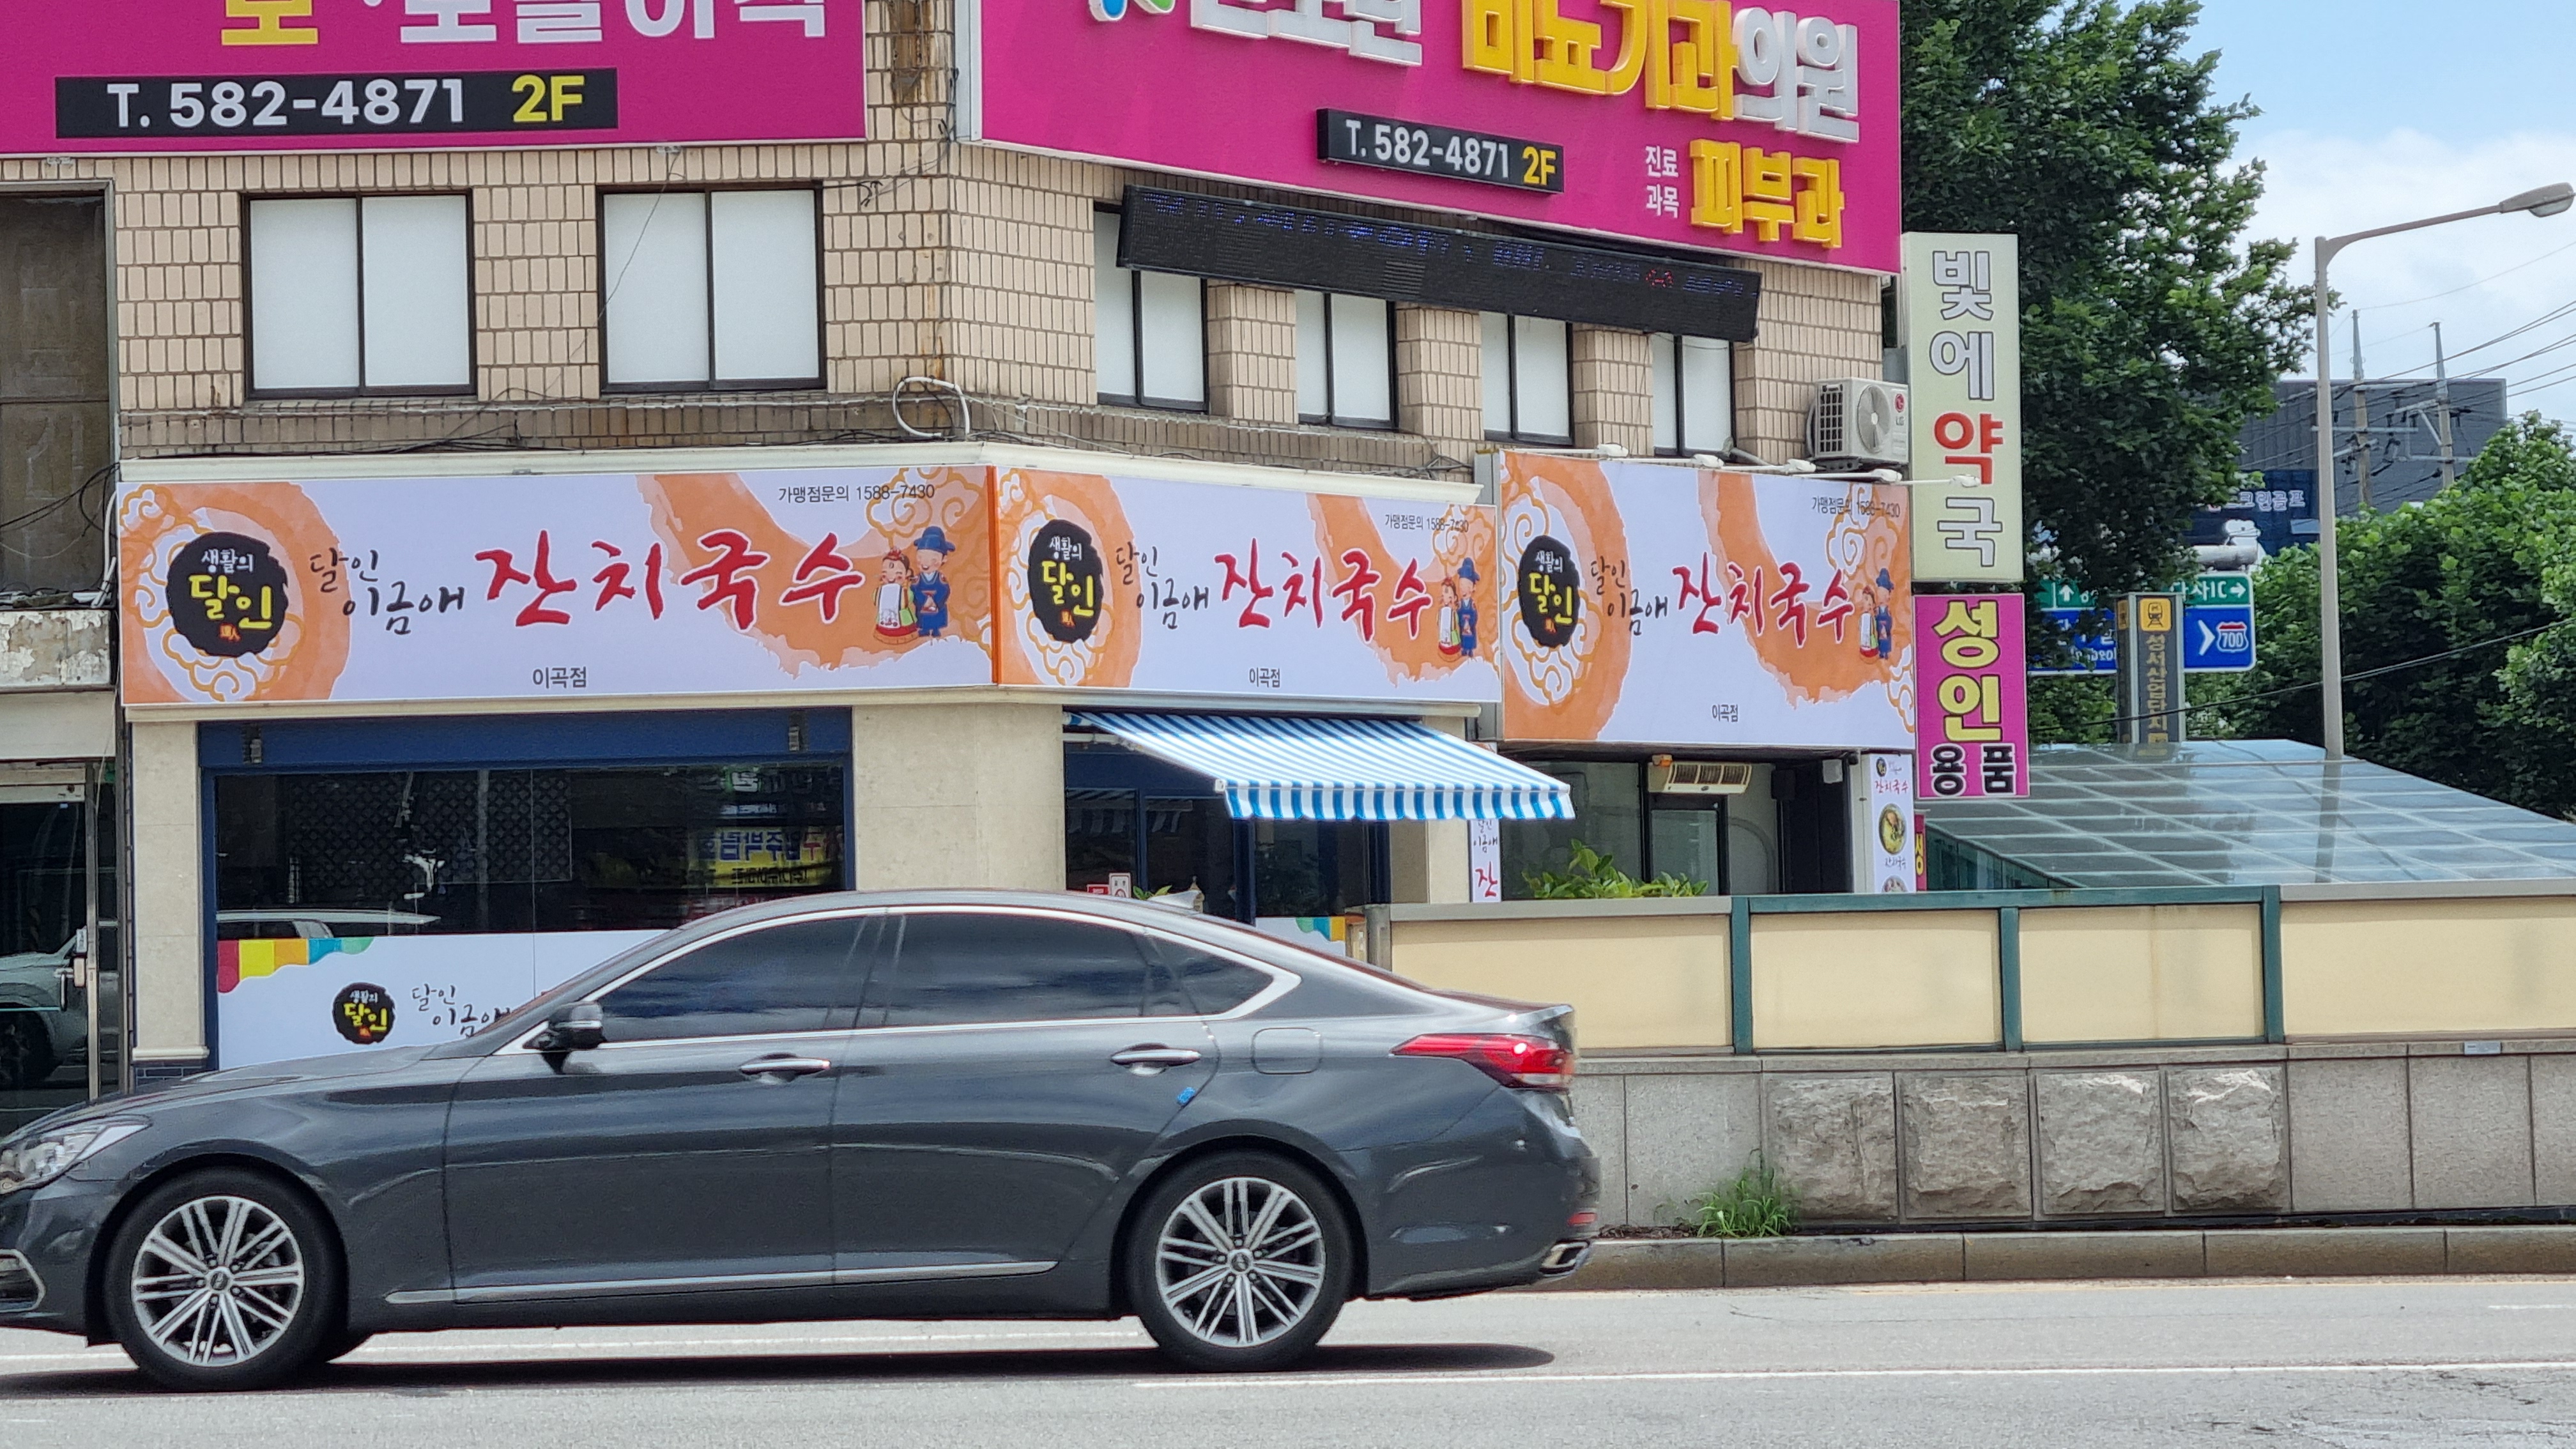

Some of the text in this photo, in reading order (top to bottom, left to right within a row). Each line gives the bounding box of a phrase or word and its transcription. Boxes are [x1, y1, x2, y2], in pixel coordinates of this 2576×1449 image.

[107, 75, 584, 128] T. 582-4871 2F
[1346, 119, 1557, 186] T. 582-4871 2F
[1645, 146, 1679, 178] 진료
[1646, 184, 1680, 218] 과목
[1690, 139, 1845, 249] 피부과
[779, 484, 935, 503] 가맹점문의 1588-7430
[1385, 513, 1469, 533] 가맹점문의 1588-7430
[201, 548, 254, 574] 생활의
[1050, 535, 1082, 562] 생활의
[1116, 541, 1158, 586] 달인
[1535, 549, 1563, 574] 생활의
[310, 548, 378, 592] 달인
[475, 529, 864, 631] 잔치국수
[1041, 560, 1094, 617] 달인
[1591, 555, 1626, 595] 달인
[188, 575, 272, 630] 달인
[1214, 538, 1433, 642] 잔치국수
[1528, 572, 1573, 624] 달인
[1672, 551, 1854, 648] 잔치국수
[2221, 632, 2244, 648] 700
[532, 666, 587, 689] 이곡점
[1248, 667, 1281, 689] 이곡점
[1931, 599, 2003, 742] 성인
[1711, 703, 1739, 723] 이곡점
[1874, 778, 1909, 795] 잔치국수
[1931, 744, 2016, 796] 용품
[1475, 861, 1498, 898] 잔
[412, 984, 456, 1011] 달인
[344, 1002, 387, 1031] 달인
